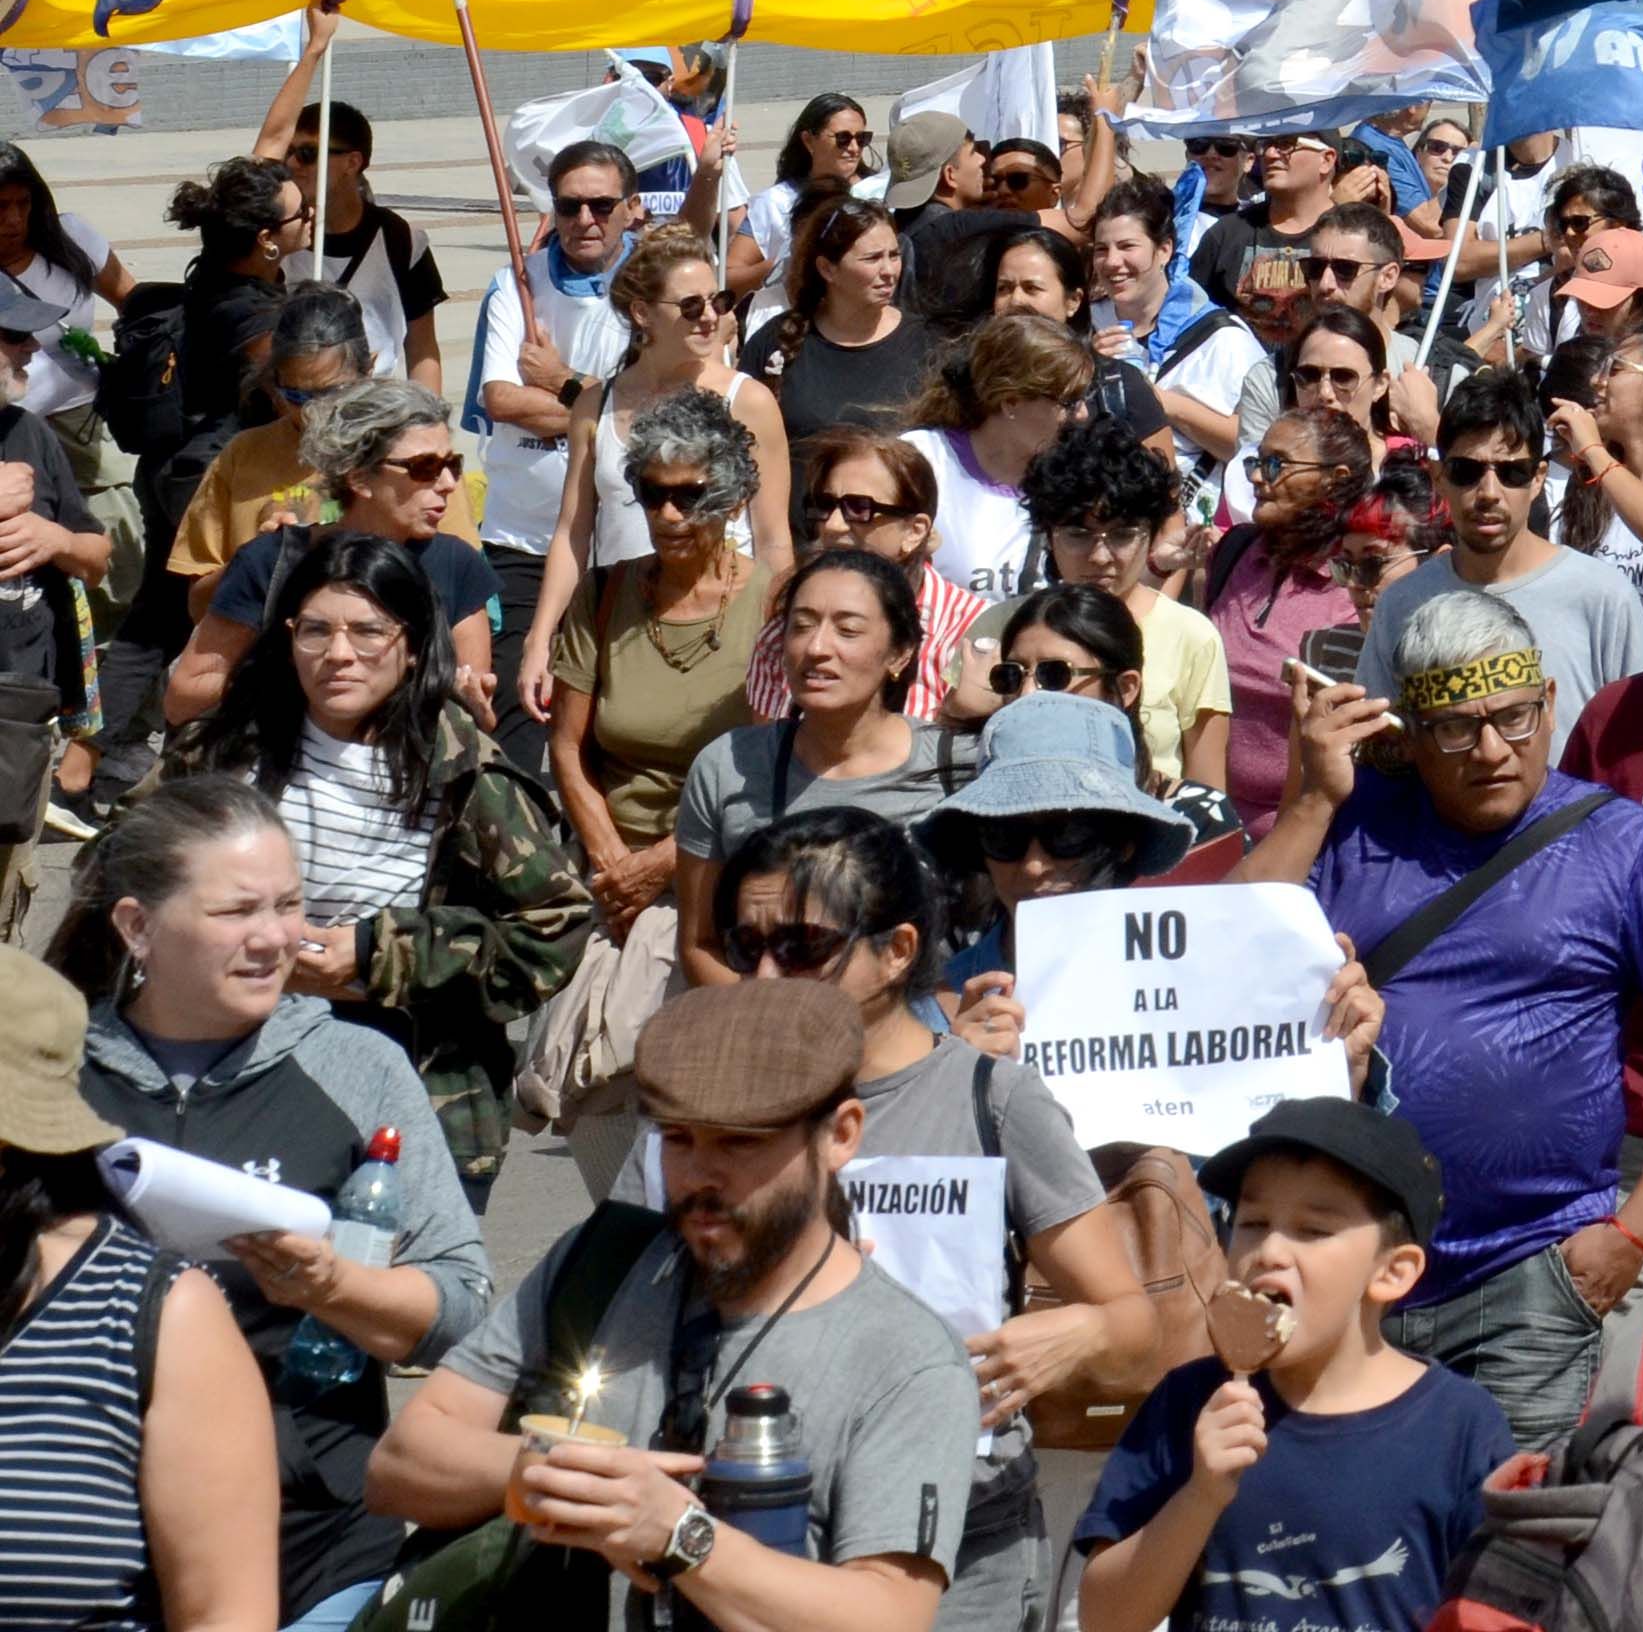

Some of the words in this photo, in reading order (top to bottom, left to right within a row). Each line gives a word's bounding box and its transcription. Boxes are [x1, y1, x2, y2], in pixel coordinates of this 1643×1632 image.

[1124, 910, 1187, 962] NO
[1133, 989, 1147, 1013] A
[1154, 987, 1179, 1012] LA
[1024, 1031, 1157, 1077] REFORMA
[1168, 1020, 1312, 1067] LABORAL
[1143, 1097, 1194, 1117] aten
